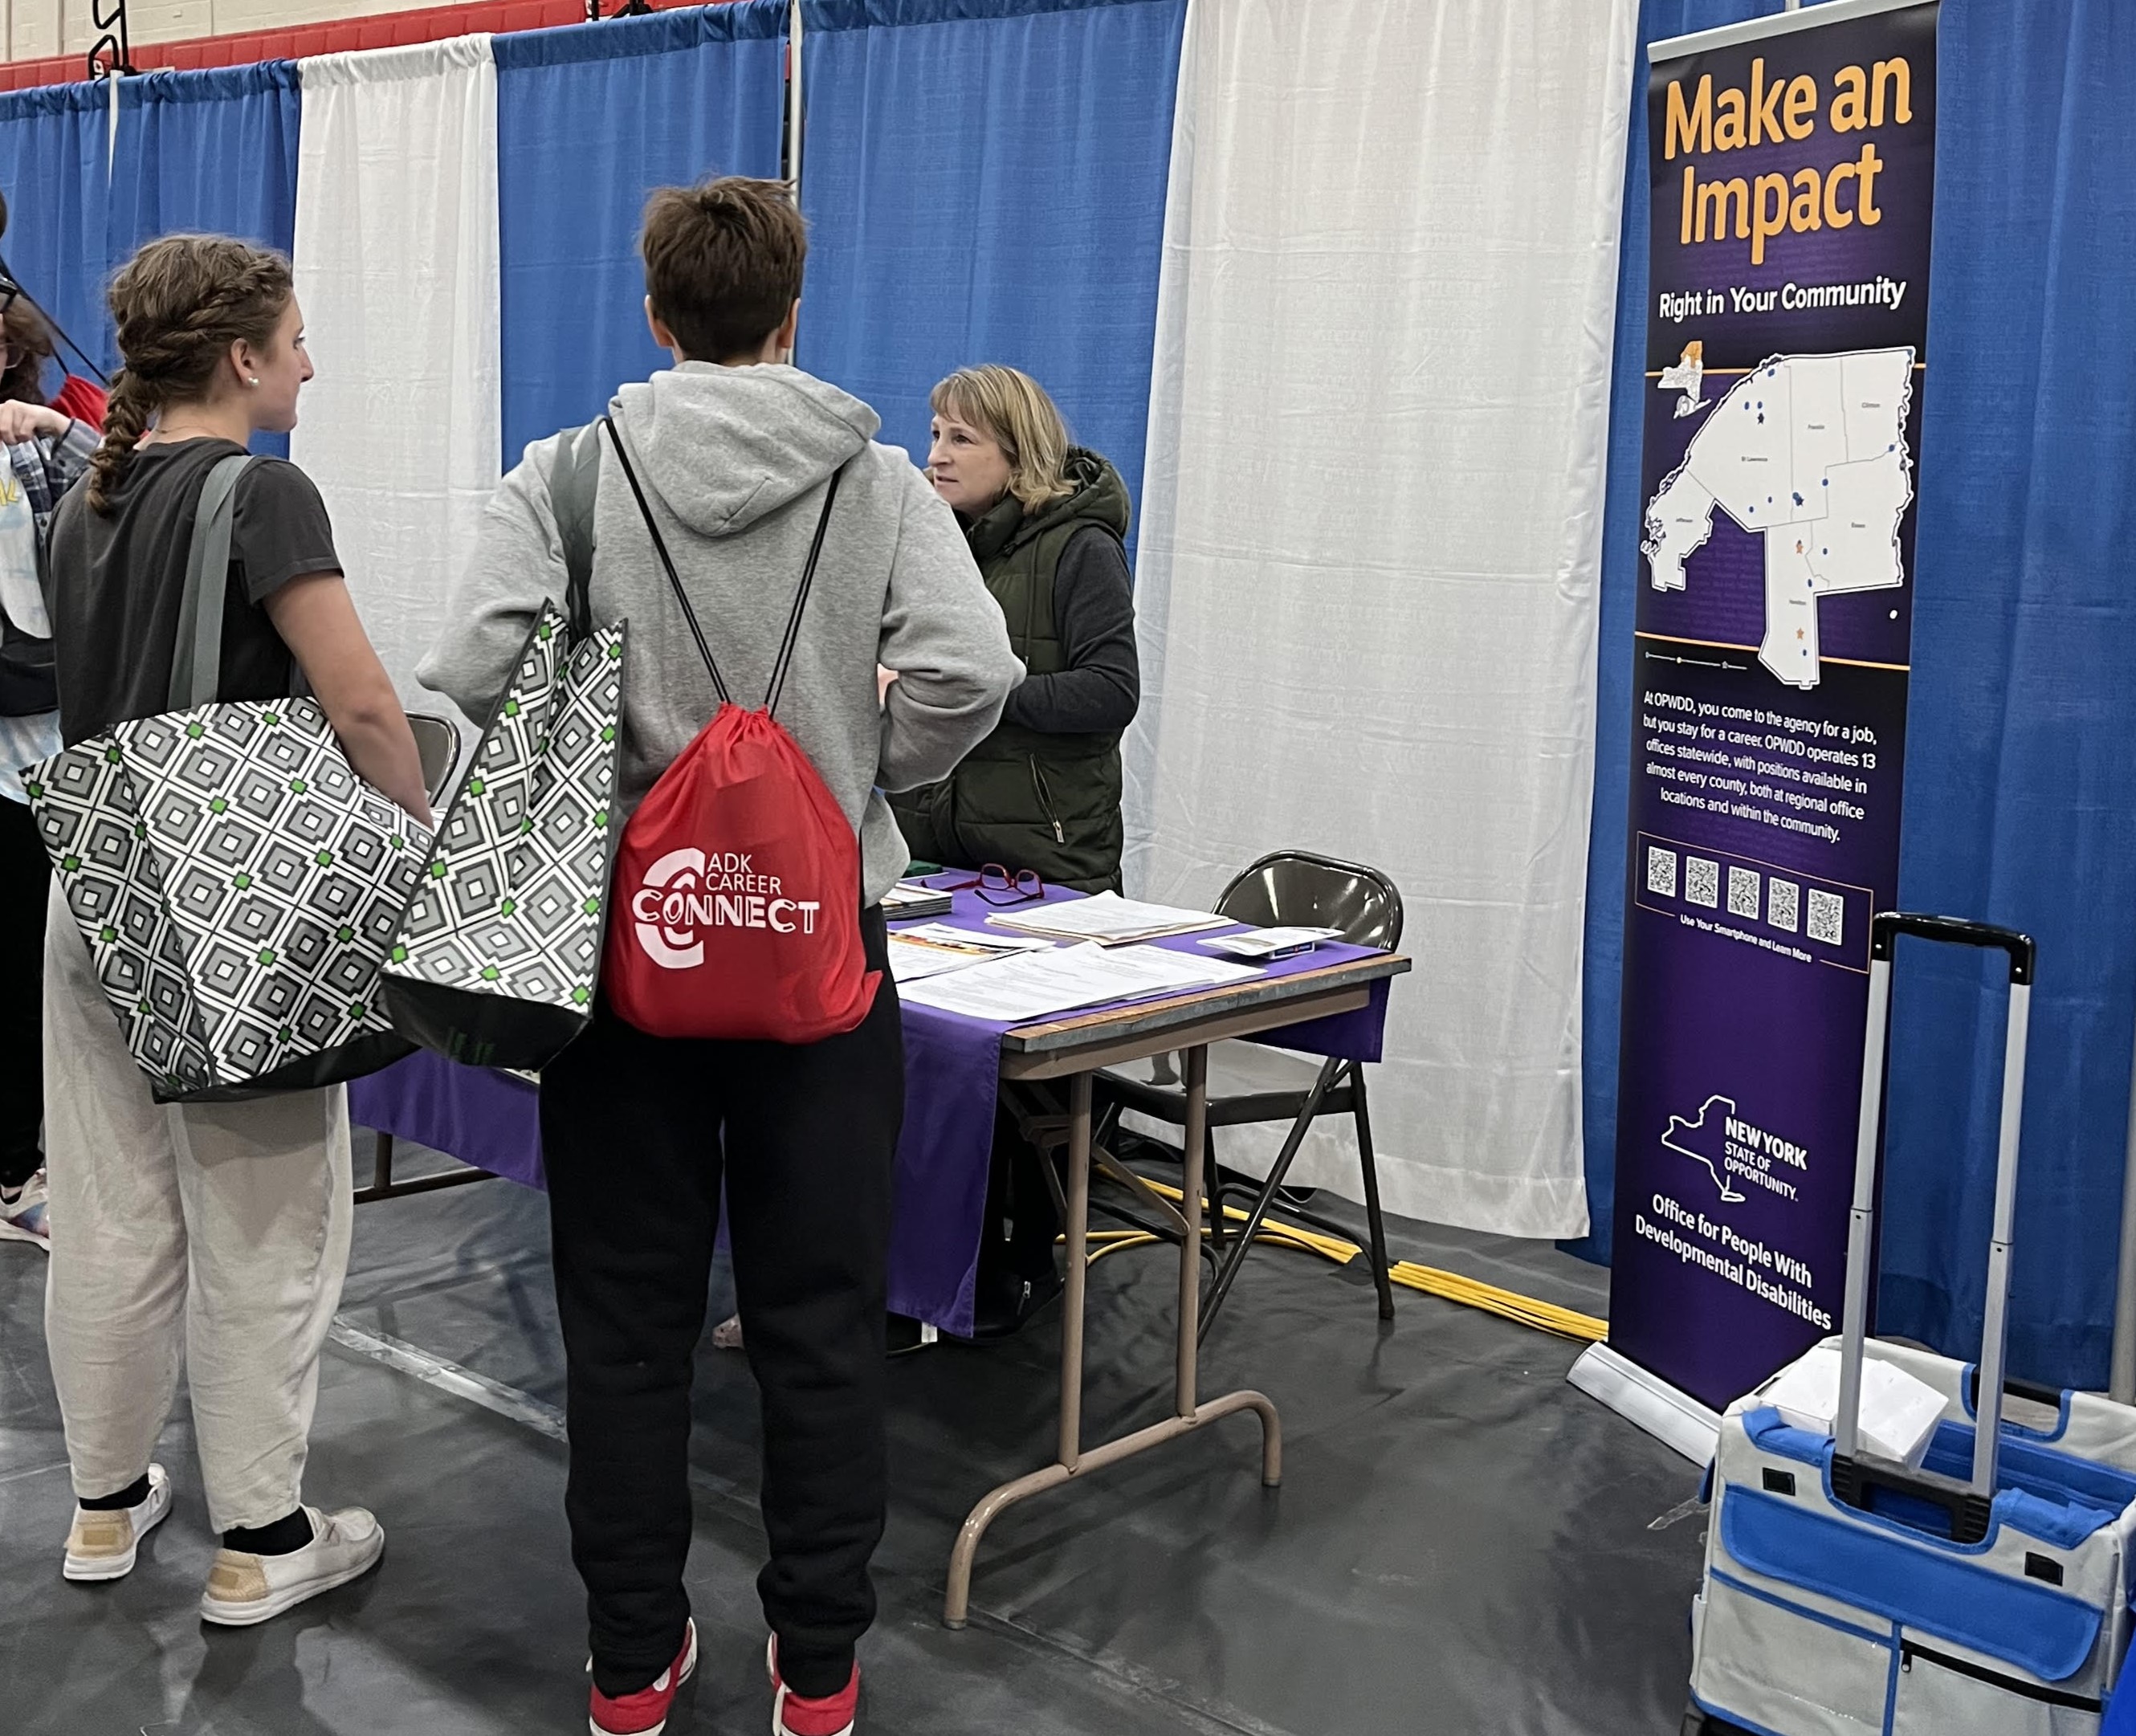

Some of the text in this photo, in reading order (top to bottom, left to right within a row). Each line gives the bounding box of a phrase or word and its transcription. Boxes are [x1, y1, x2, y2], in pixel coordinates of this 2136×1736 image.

[1665, 57, 1912, 160] Make an
[1681, 143, 1882, 265] Impact
[1659, 275, 1906, 323] Right in Your Community
[1643, 713, 1876, 769] but you stay for a career. OPWDD operates 13
[1644, 691, 1877, 745] At OPWDD, you come to the agency for a job,
[1646, 738, 1867, 794] offices statewide, with positions available in
[1646, 761, 1865, 820] almost every county, both at regional office
[1661, 787, 1840, 843] locations and within the community.
[706, 873, 781, 895] CAREER
[707, 853, 752, 874] ADK
[632, 889, 820, 934] CONNECT
[1680, 914, 1695, 927] Use
[1696, 918, 1714, 931] Your
[1759, 938, 1771, 949] and
[1792, 947, 1812, 963] More
[1725, 1141, 1771, 1172] STATE OF
[1726, 1116, 1807, 1170] NEW YORK
[1653, 1194, 1812, 1288] Office for People With
[1636, 1214, 1831, 1330] Developmental Disabilities
